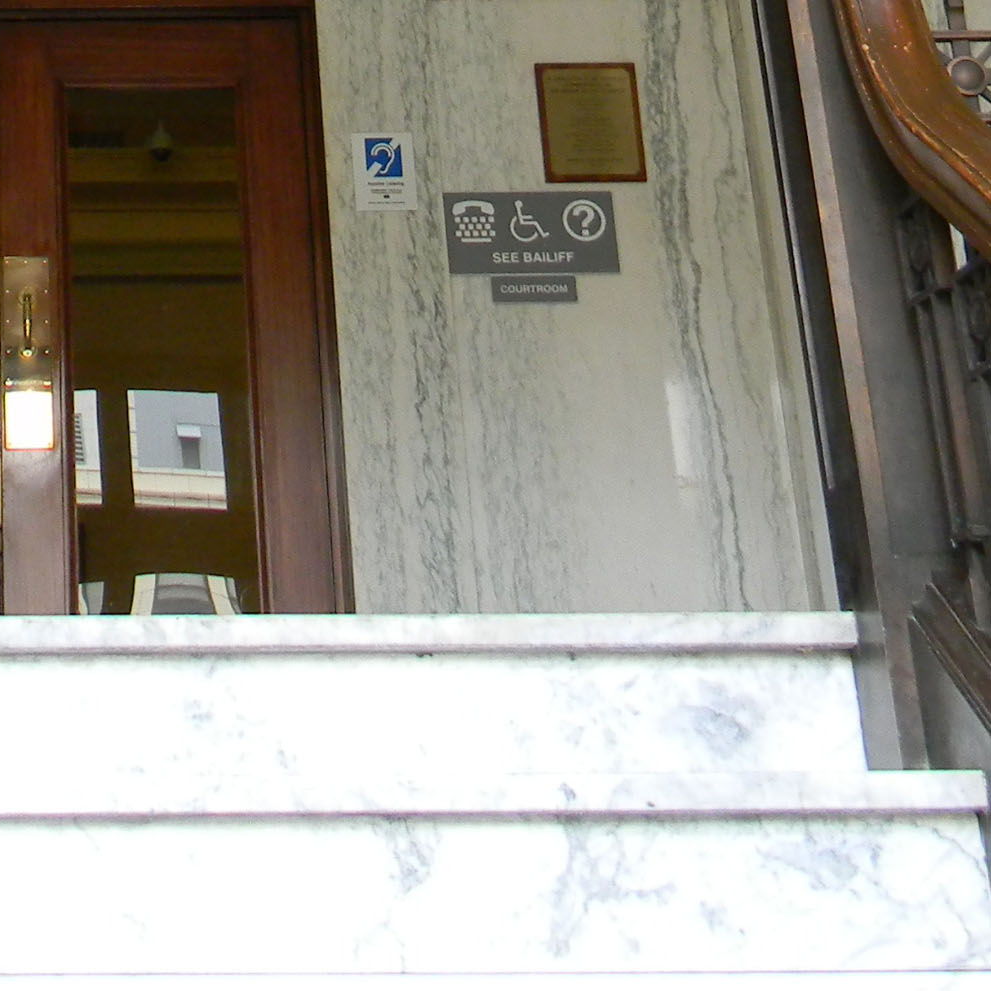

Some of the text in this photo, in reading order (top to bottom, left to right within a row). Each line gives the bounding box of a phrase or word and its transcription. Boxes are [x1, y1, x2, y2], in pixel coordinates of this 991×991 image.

[492, 251, 575, 264] SEE BAILIFF
[500, 284, 568, 294] COURTROOM
